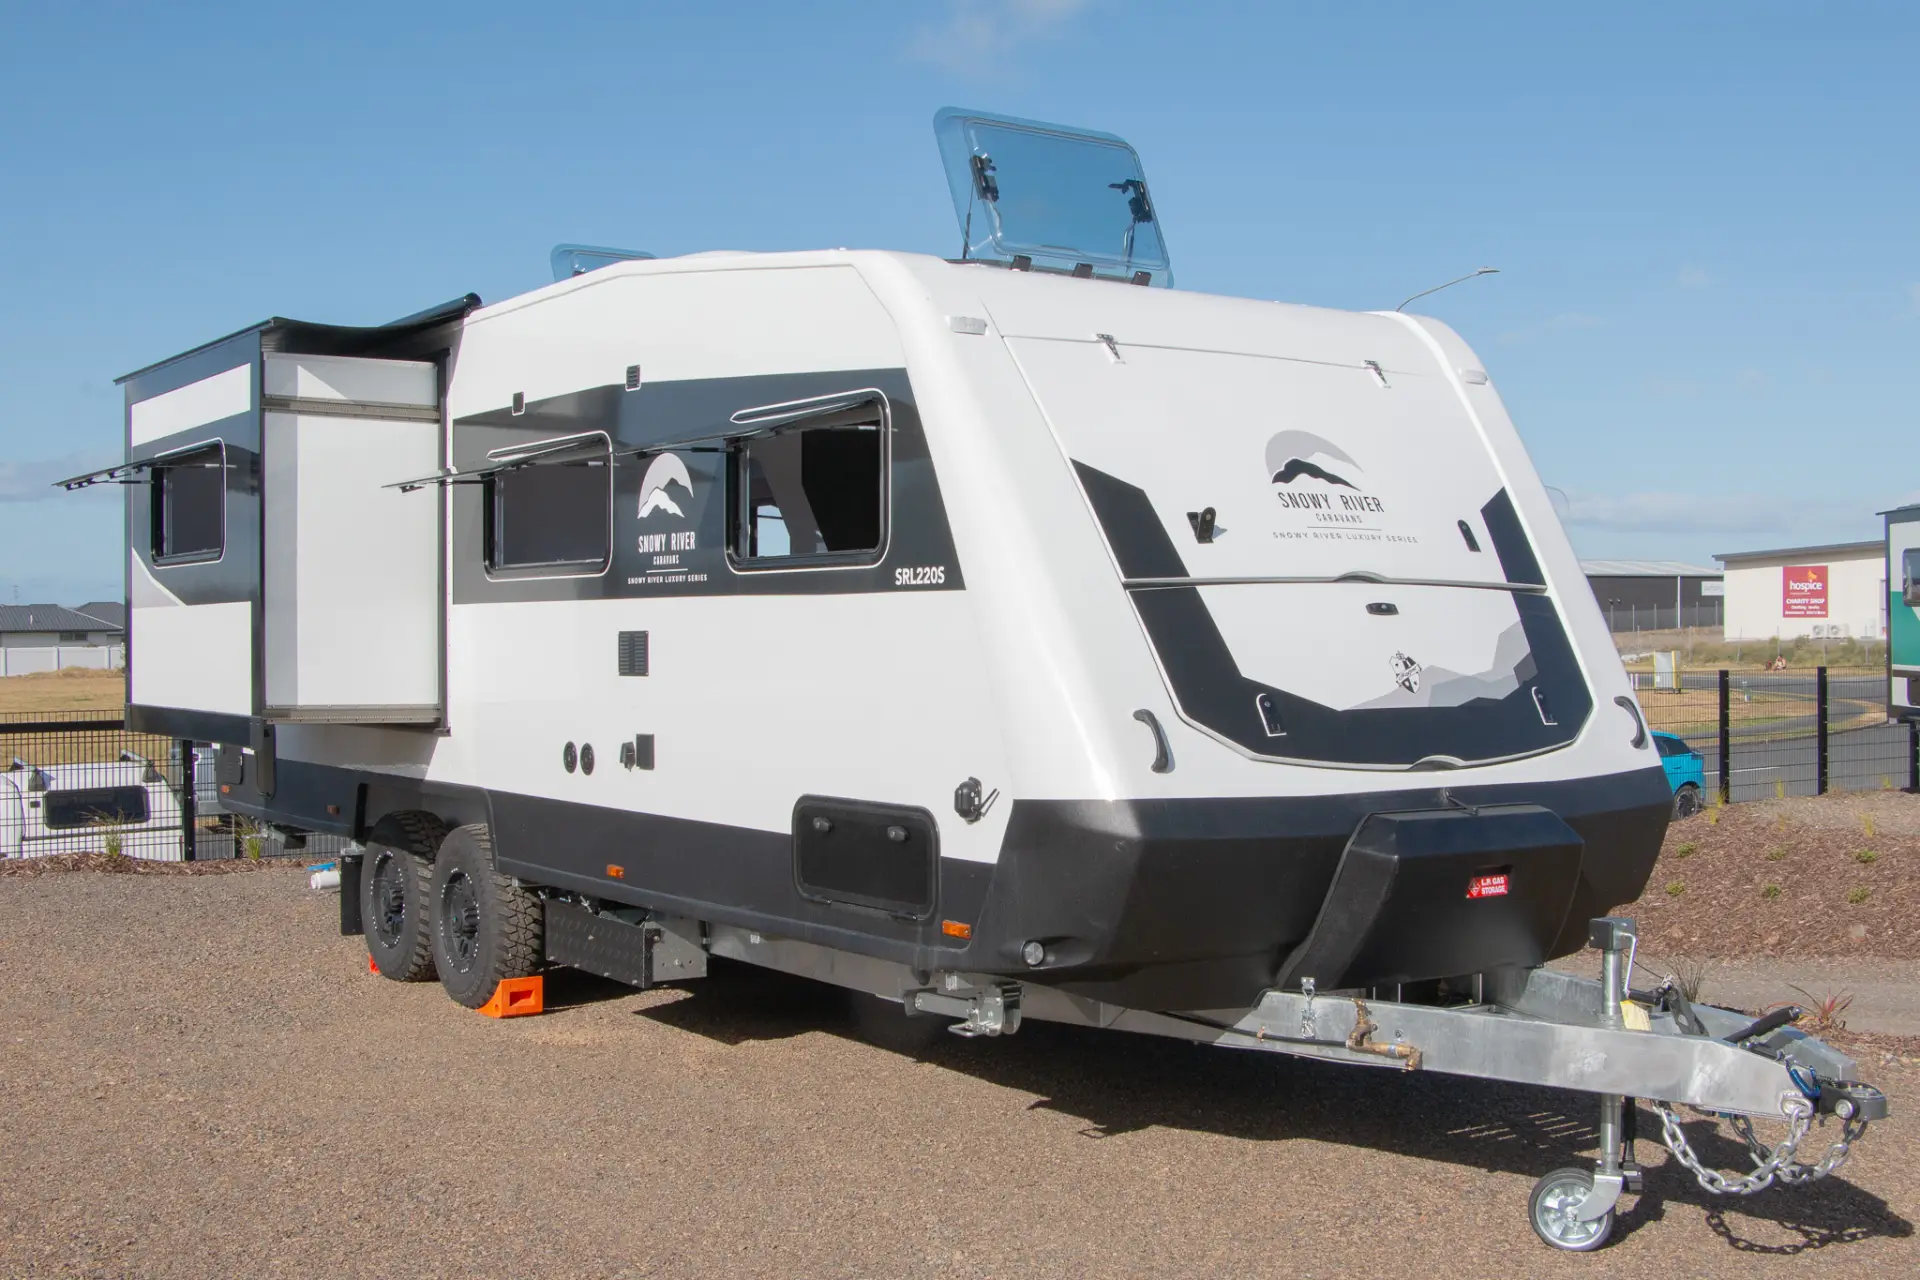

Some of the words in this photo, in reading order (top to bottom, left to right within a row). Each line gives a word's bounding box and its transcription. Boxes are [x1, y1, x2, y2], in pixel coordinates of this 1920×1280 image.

[1277, 492, 1331, 510] SNOWY
[1339, 494, 1385, 513] RIVER
[1315, 513, 1363, 523] CARAVANS
[638, 533, 666, 553] SNOWY
[671, 531, 696, 551] RIVER
[1272, 531, 1308, 539] SNOWY
[1312, 532, 1342, 540] RIVER
[1346, 533, 1382, 541] LUXURY
[1386, 535, 1418, 544] SERIES
[653, 554, 680, 565] CARAVANS
[627, 577, 646, 585] SNOWY
[647, 575, 663, 584] RIVER
[664, 575, 686, 583] LUXURY
[687, 573, 708, 582] SERIES
[895, 566, 945, 585] SRL220S
[1789, 579, 1823, 592] hospice
[1492, 876, 1505, 885] GAS
[1481, 885, 1505, 895] STORAGE
